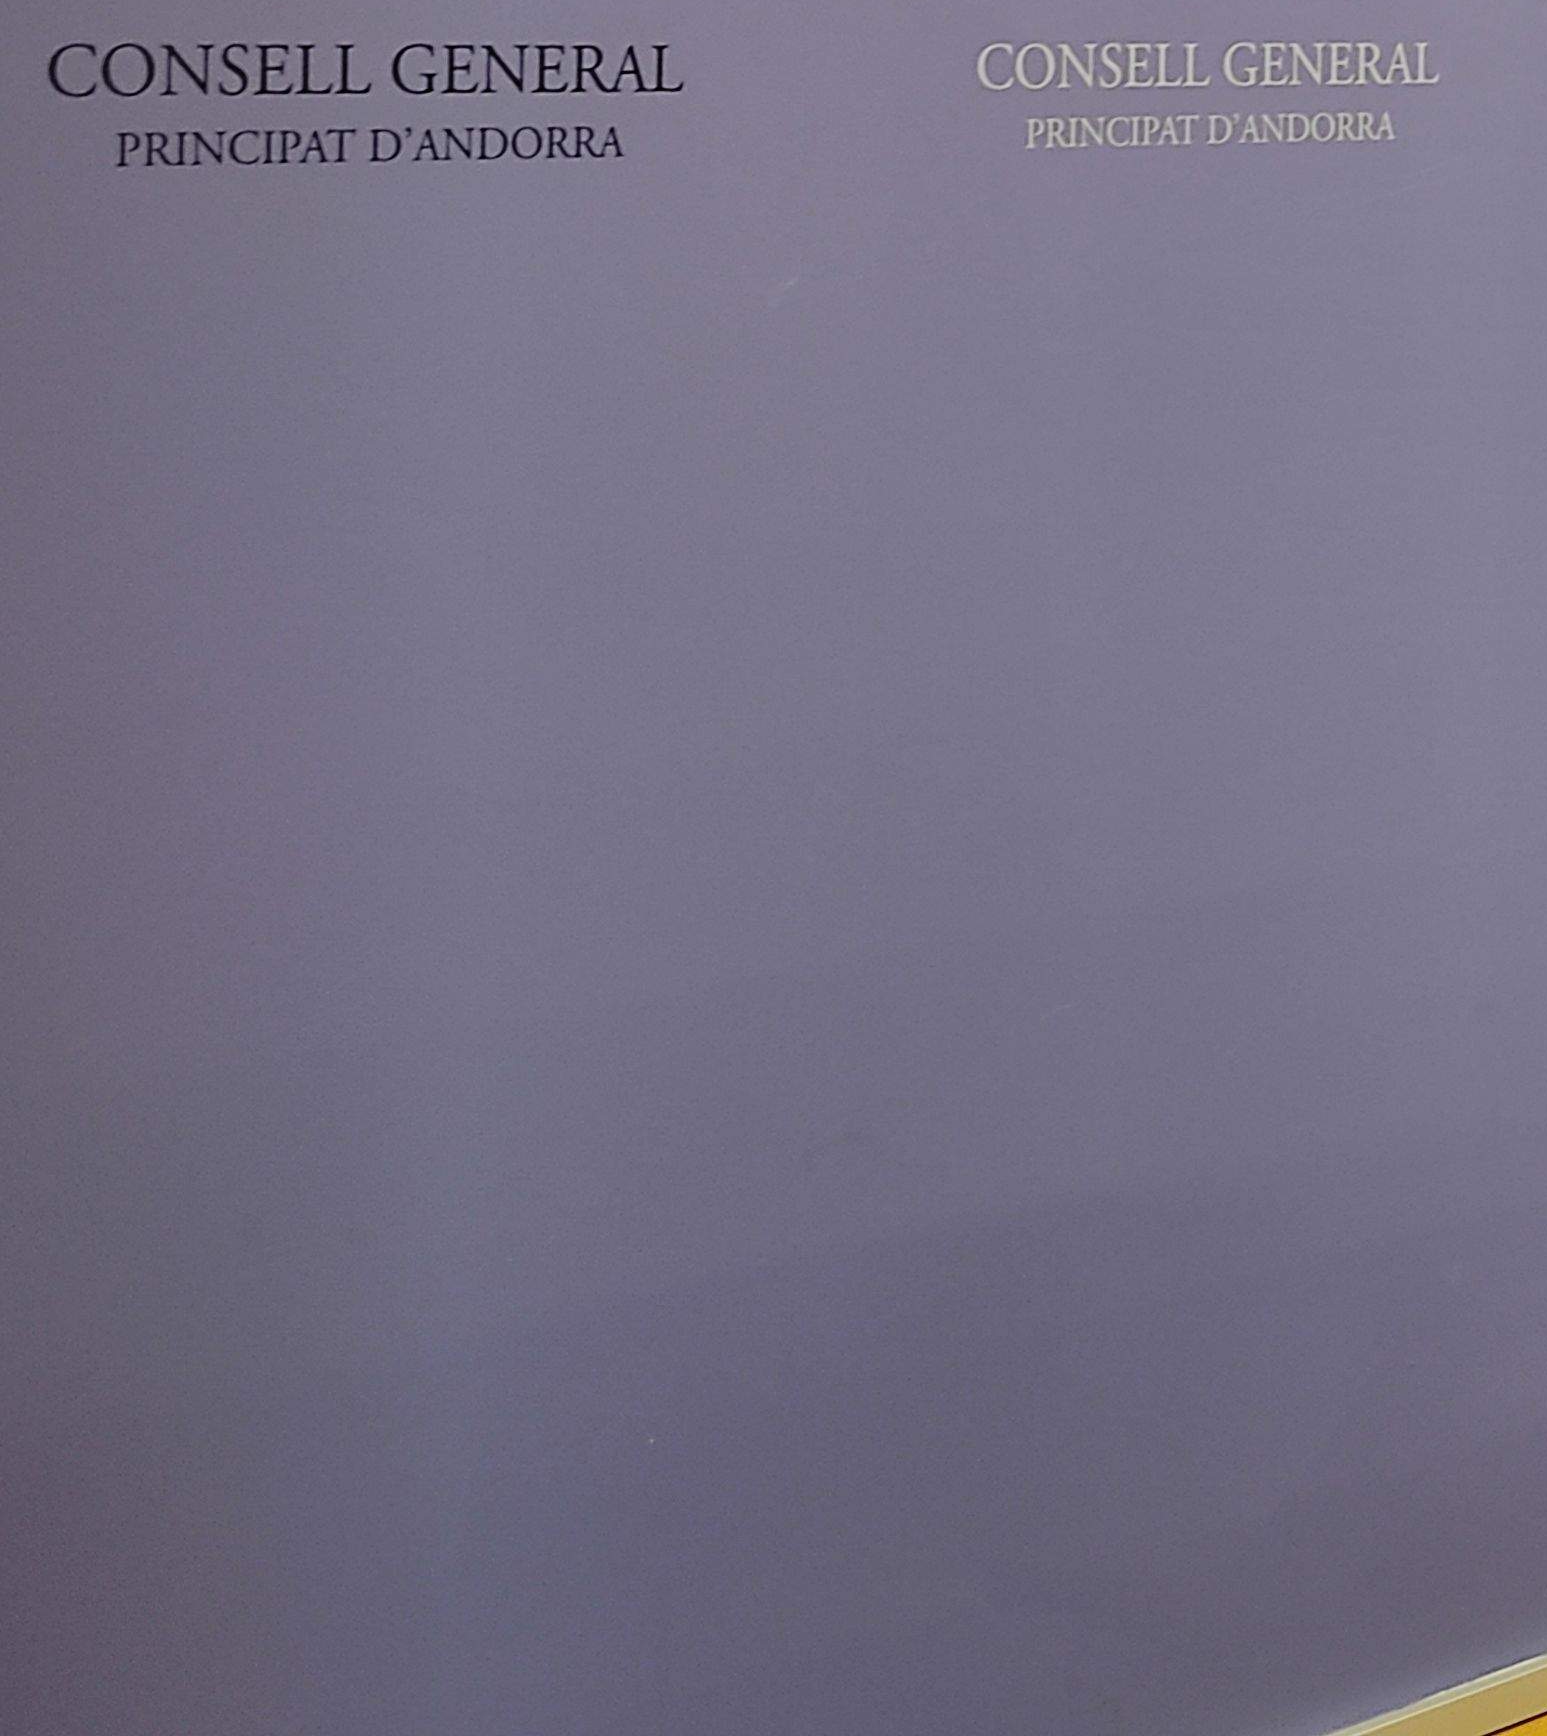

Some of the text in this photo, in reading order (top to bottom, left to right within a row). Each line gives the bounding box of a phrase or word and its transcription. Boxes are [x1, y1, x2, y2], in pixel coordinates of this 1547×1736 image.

[47, 42, 685, 97] CONSELL GENERAL
[976, 40, 1440, 90] CONSELL GENERAL
[116, 125, 625, 167] PRINCIPAT D'ANDORRA
[1025, 111, 1396, 149] PRINCIPAT D'ANDORRA
